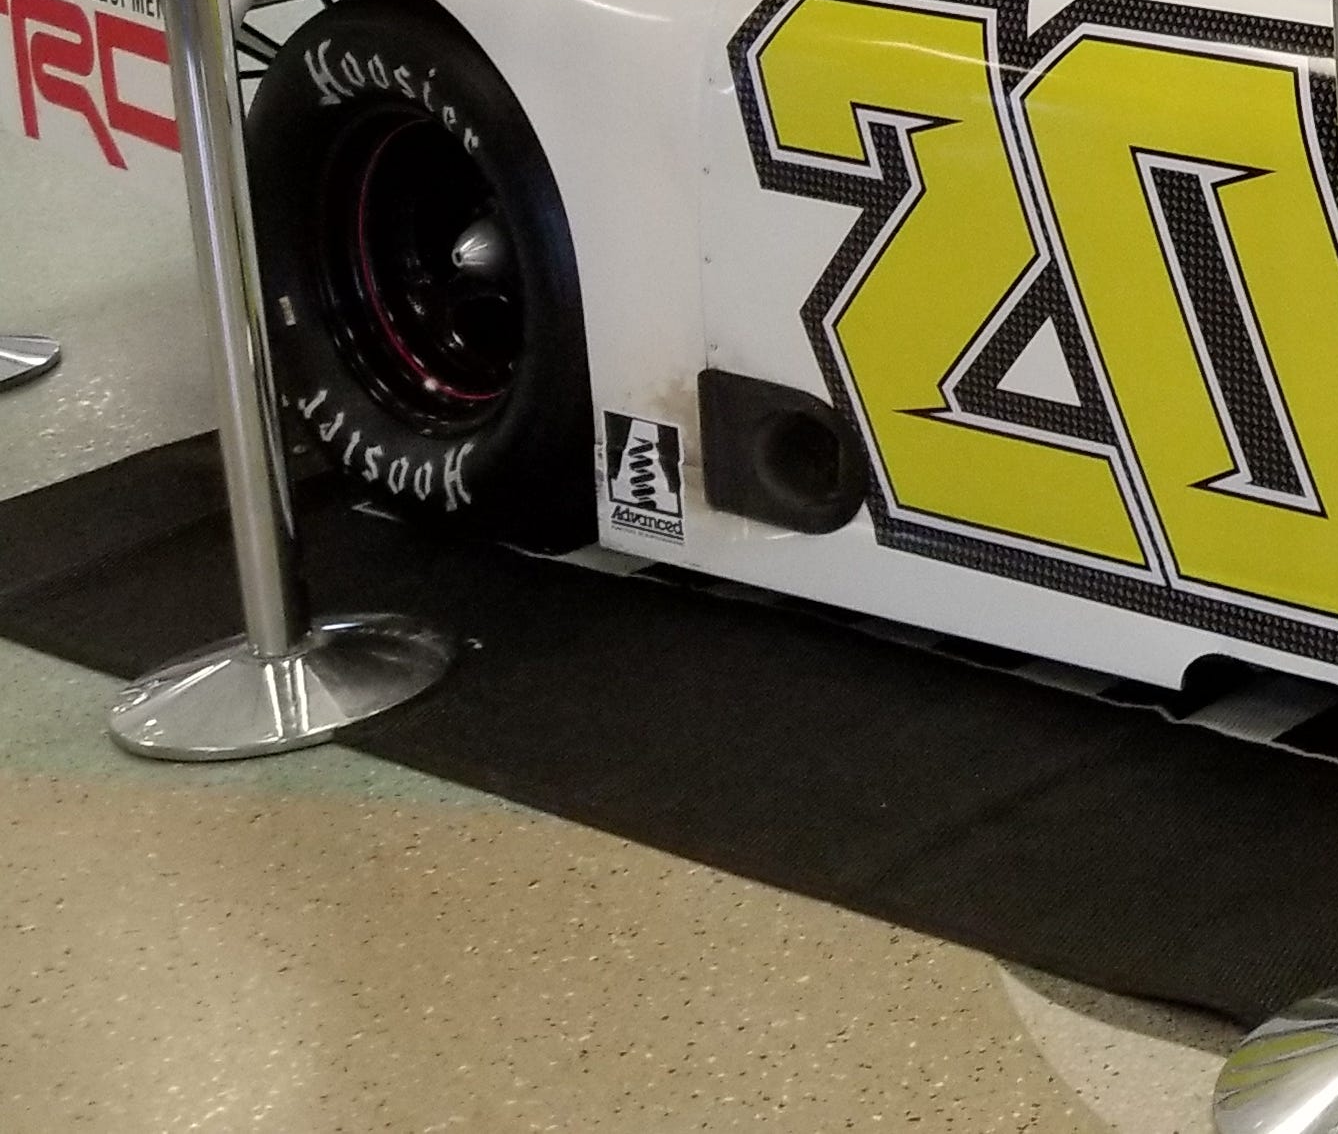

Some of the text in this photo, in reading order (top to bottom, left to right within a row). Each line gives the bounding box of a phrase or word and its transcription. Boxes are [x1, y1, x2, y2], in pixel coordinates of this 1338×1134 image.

[303, 38, 480, 154] Hoosier
[298, 388, 475, 512] Hoosier
[611, 505, 684, 536] Advanced
